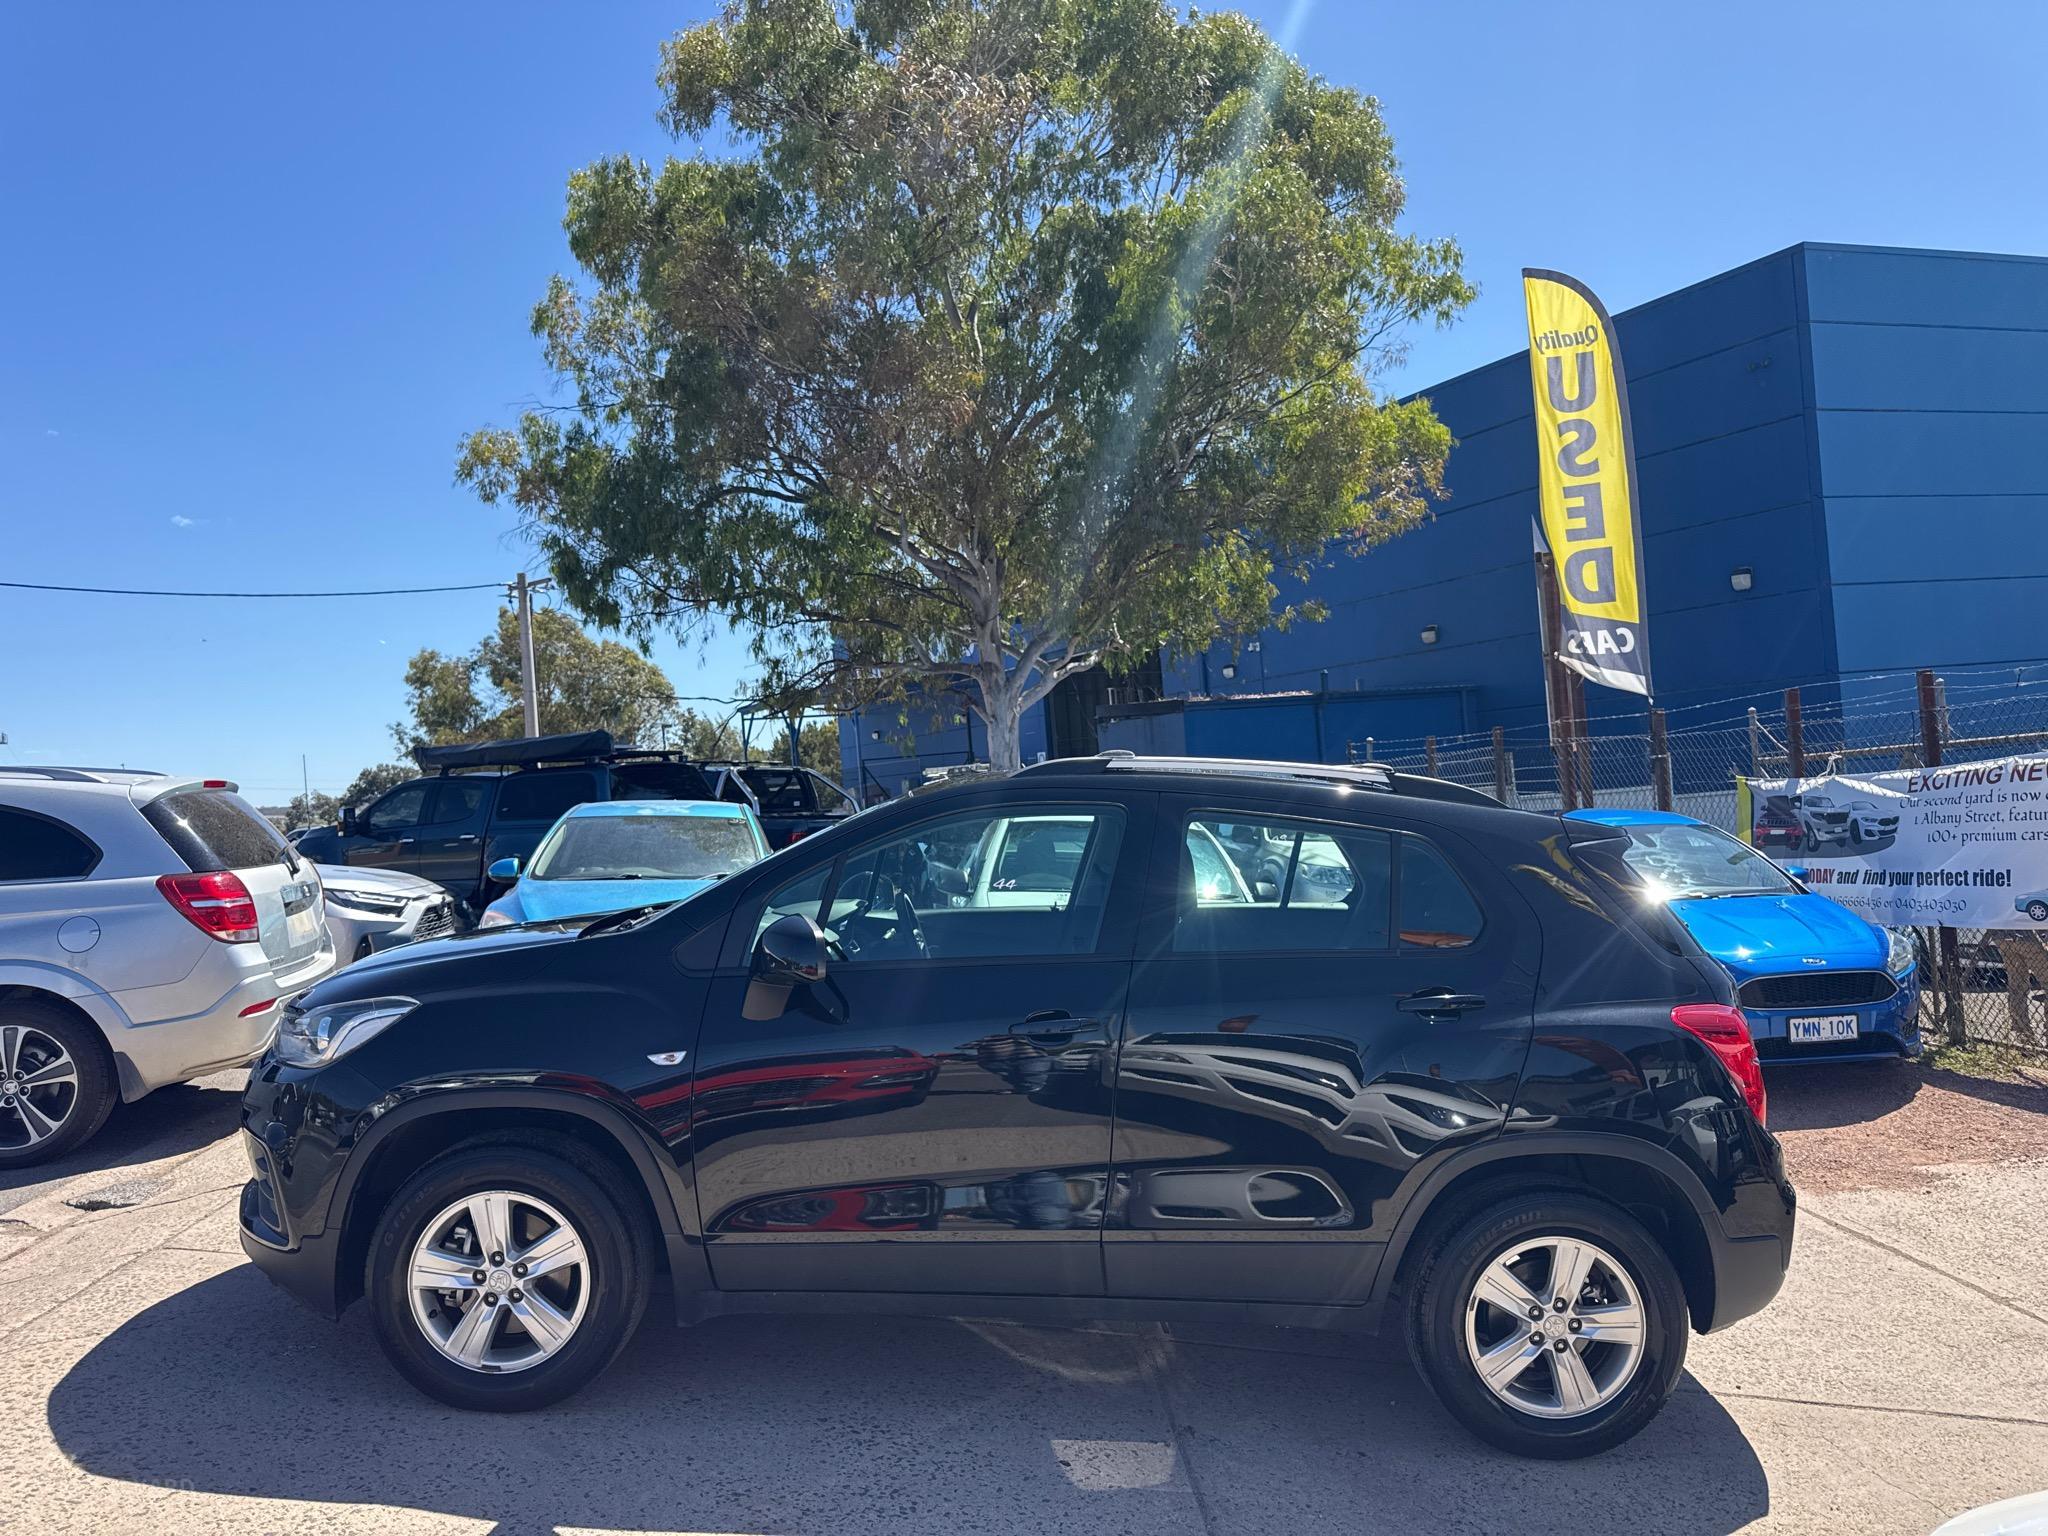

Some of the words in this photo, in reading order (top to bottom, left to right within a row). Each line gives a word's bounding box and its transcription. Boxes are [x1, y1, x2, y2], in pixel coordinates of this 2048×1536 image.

[1907, 766, 2003, 793] EXCITING
[2010, 762, 2048, 782] NE
[1900, 796, 1921, 808] Our
[1923, 791, 1963, 807] second
[1965, 788, 1993, 808] yard
[1998, 788, 2007, 802] is
[2011, 791, 2041, 801] now
[1921, 810, 1961, 827] Albany
[1965, 809, 2004, 823] Street,
[1928, 829, 1957, 842] 100+
[1961, 826, 2016, 846] premium
[2021, 831, 2048, 840] cars
[993, 878, 1017, 890] 44
[1837, 869, 1859, 884] and
[1862, 868, 1886, 885] find
[1888, 871, 1914, 887] your
[1917, 869, 1969, 887] perfect
[1973, 869, 2011, 887] ride!
[1895, 898, 1967, 913] 0403403030
